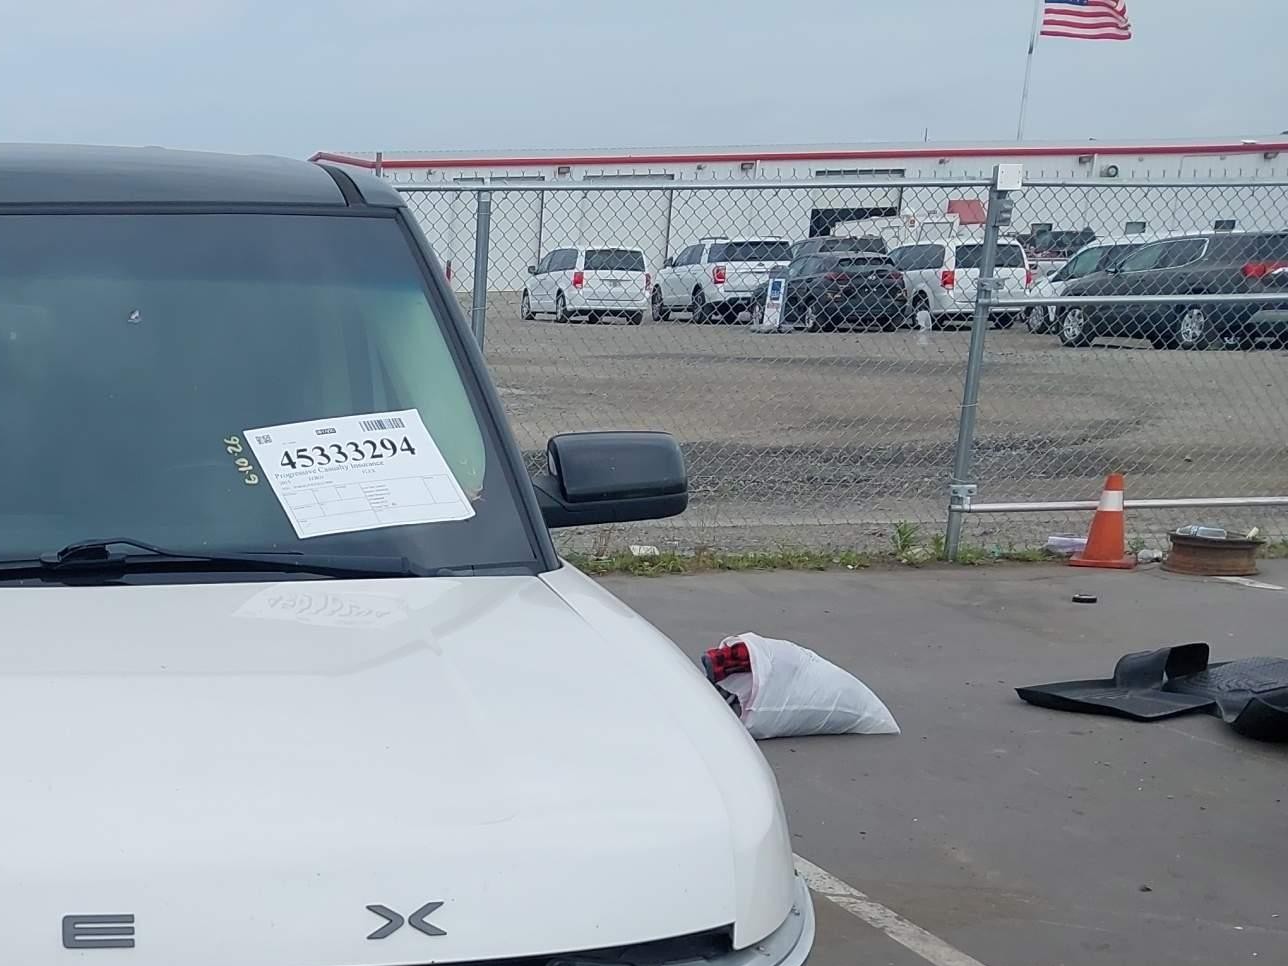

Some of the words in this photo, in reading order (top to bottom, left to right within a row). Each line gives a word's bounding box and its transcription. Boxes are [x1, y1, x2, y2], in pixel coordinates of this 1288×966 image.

[281, 435, 416, 469] 45333294
[274, 468, 317, 480] Progressive
[317, 463, 349, 475] Casualty
[350, 460, 384, 470] Insurance
